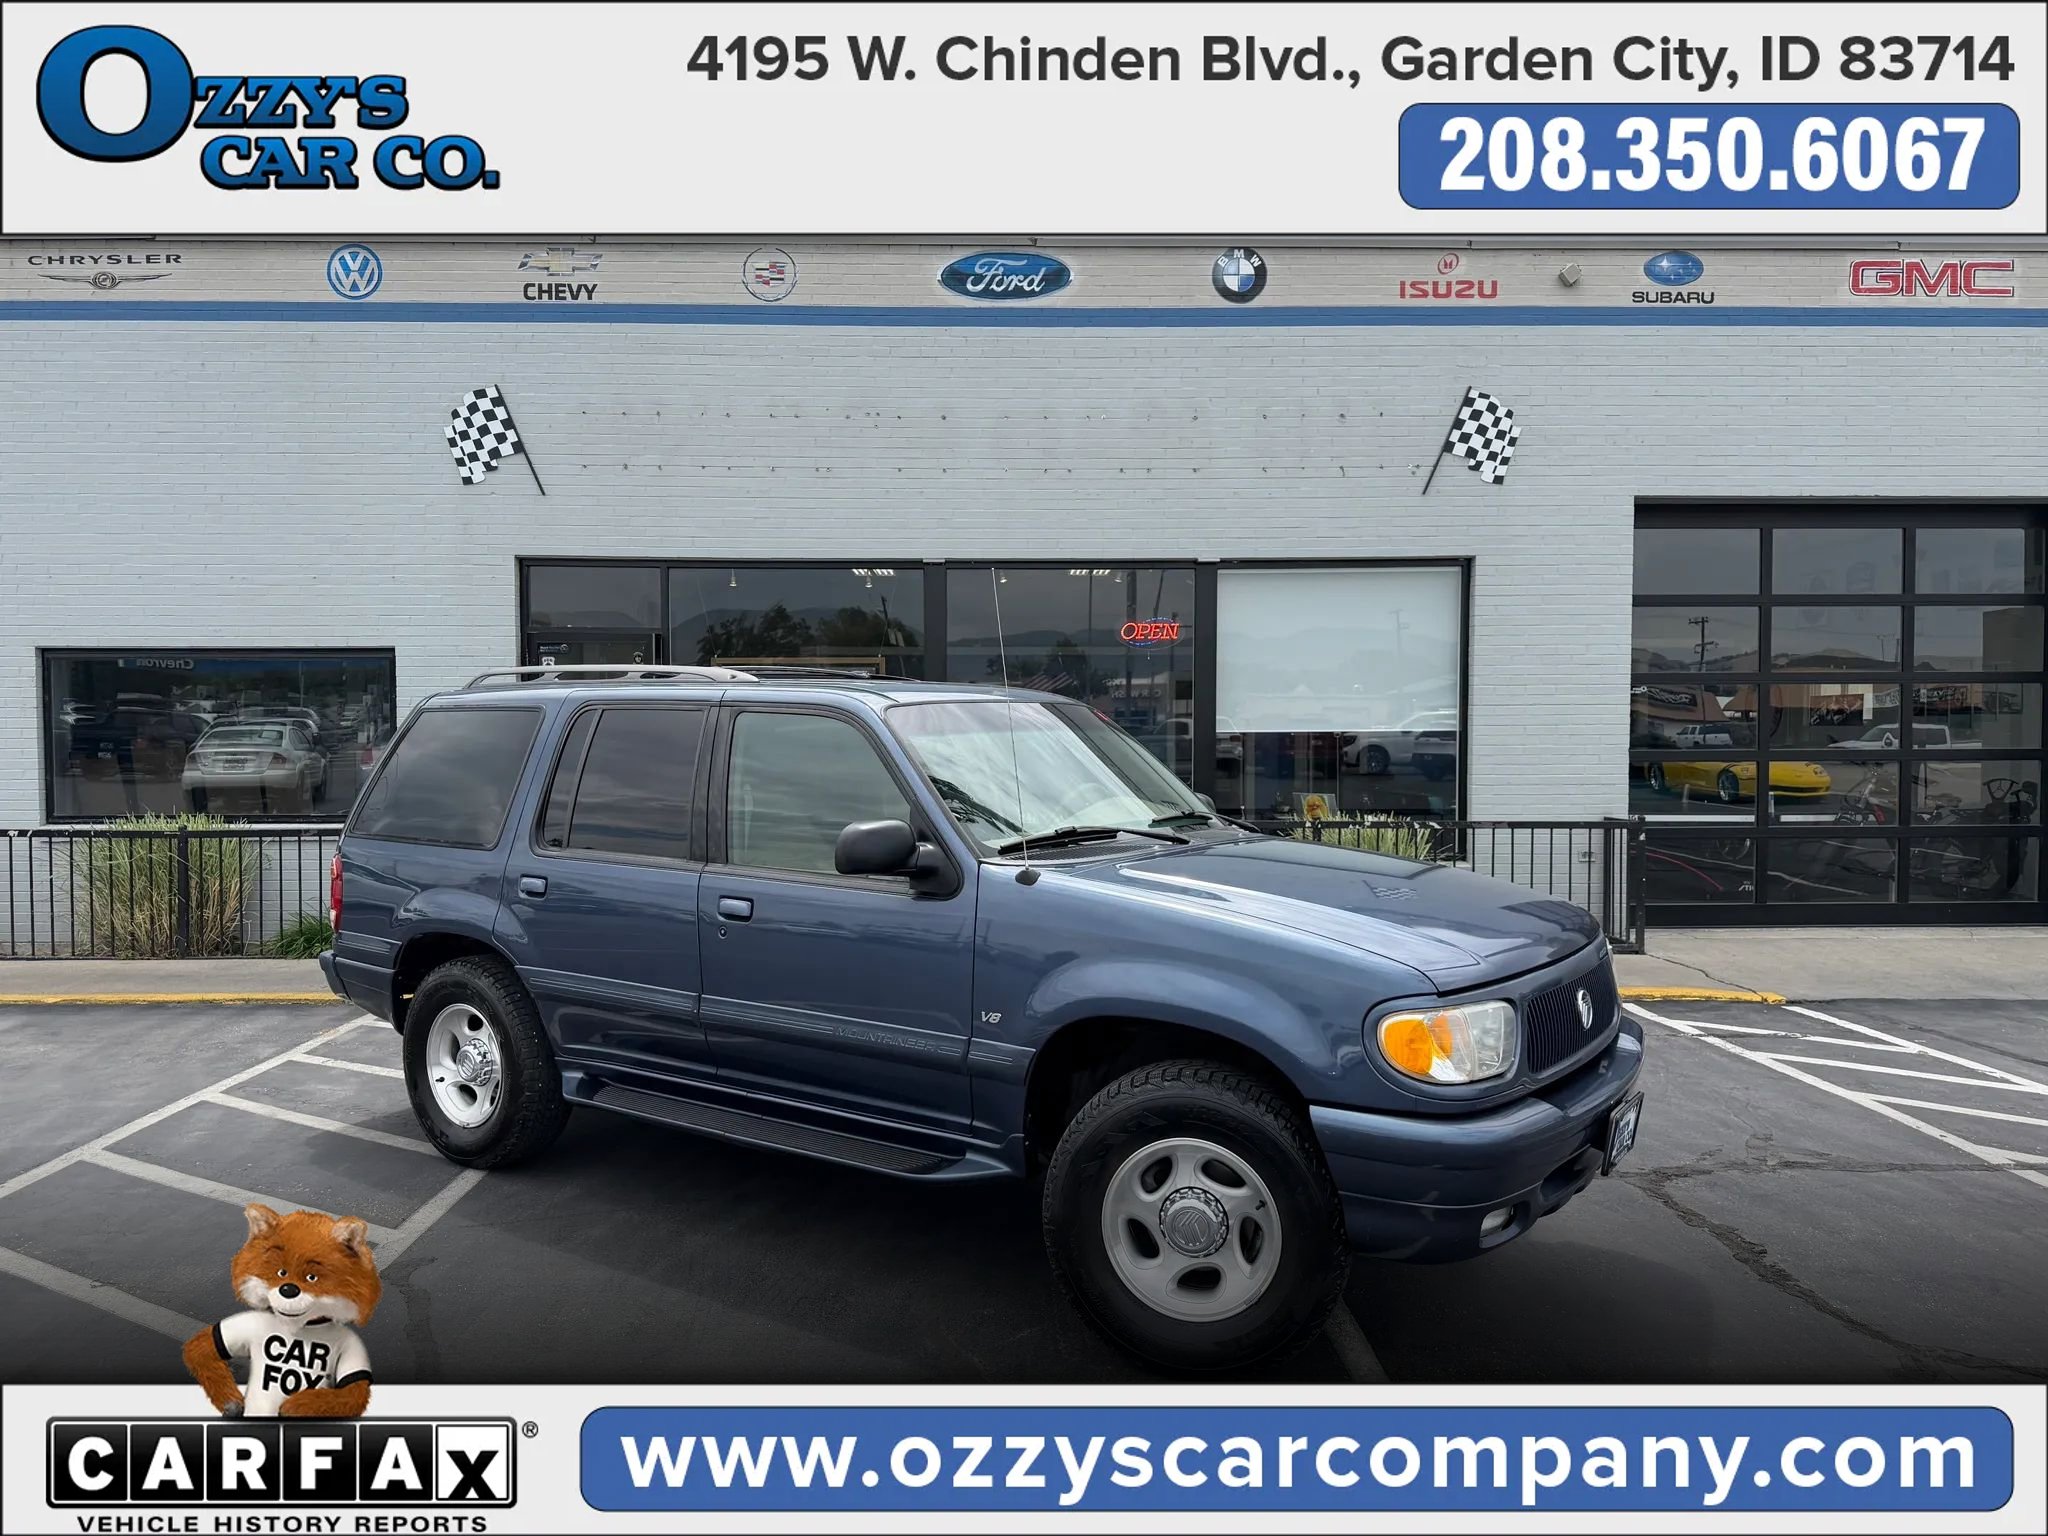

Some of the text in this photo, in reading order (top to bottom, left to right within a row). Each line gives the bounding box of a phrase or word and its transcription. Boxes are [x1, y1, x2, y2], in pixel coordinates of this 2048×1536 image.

[28, 254, 182, 265] CHRYSLER
[1217, 249, 1262, 267] BMW
[966, 258, 1046, 292] Ford
[1850, 259, 2015, 298] GMC
[523, 282, 598, 301] CHEVY
[1399, 281, 1498, 300] ISUZU
[1631, 291, 1715, 305] SUBARU
[1121, 623, 1179, 640] OPEN
[981, 1011, 1001, 1024] V8
[835, 1025, 938, 1052] MOUNTAINEER
